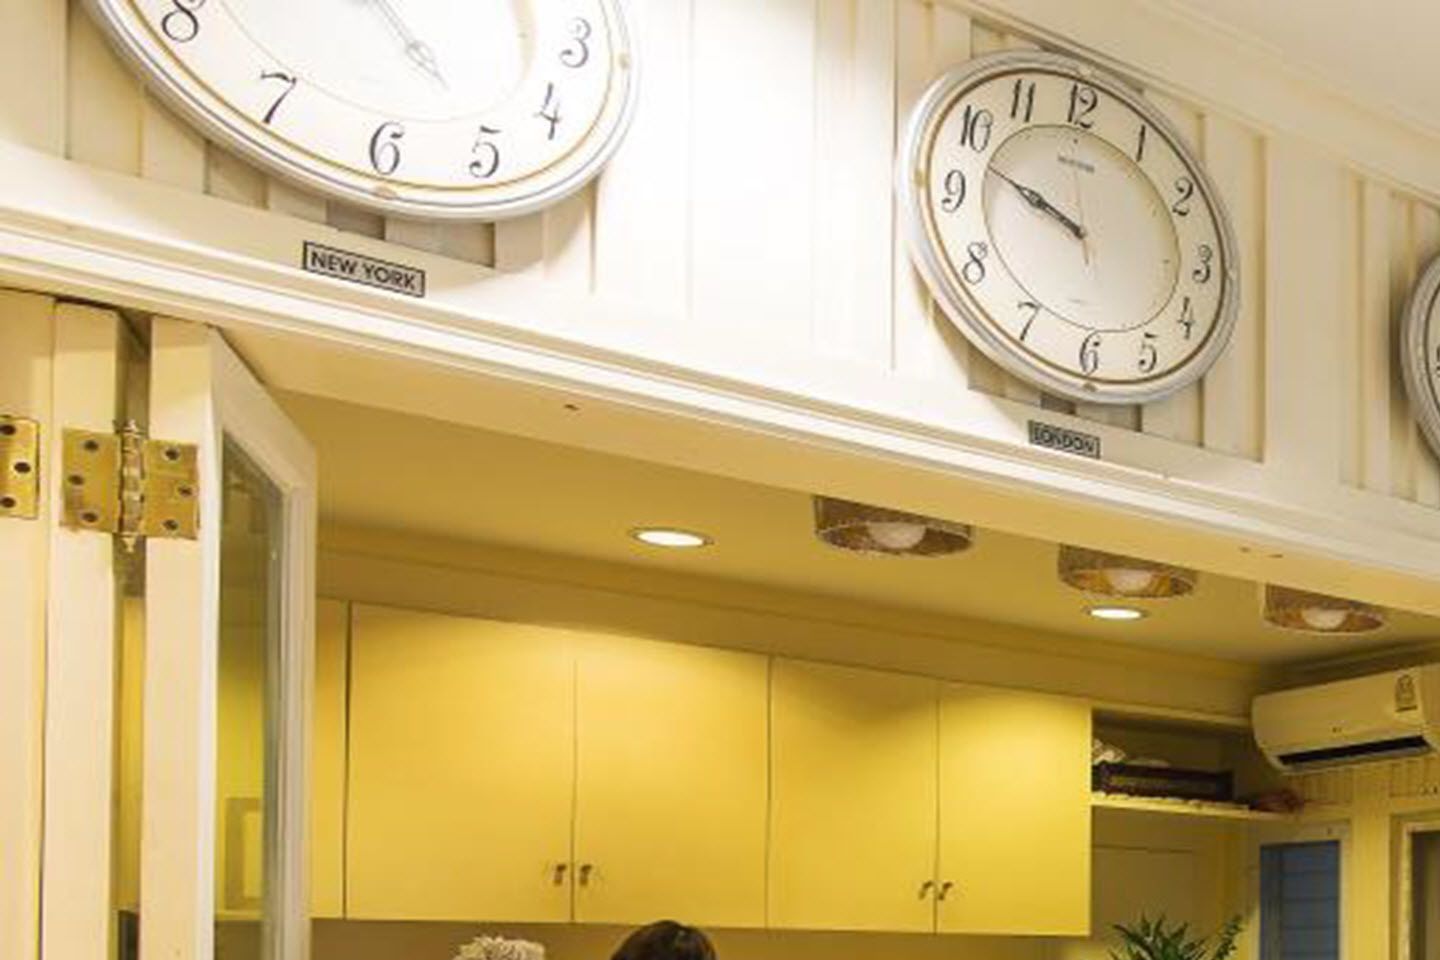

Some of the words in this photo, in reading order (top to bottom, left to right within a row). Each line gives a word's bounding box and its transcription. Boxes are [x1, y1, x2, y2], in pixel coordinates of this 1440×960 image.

[161, 0, 206, 43] 8
[560, 18, 592, 68] 3
[259, 72, 297, 124] 7
[533, 82, 560, 140] 4
[1010, 78, 1036, 123] 11
[1067, 83, 1098, 129] 12
[369, 121, 405, 175] 6
[960, 104, 994, 153] 10
[1136, 124, 1146, 162] 1
[468, 126, 499, 178] 5
[941, 169, 967, 213] 9
[1171, 176, 1193, 217] 2
[311, 250, 358, 275] NEW
[361, 263, 416, 290] YORK
[962, 240, 988, 285] 8
[1191, 244, 1212, 284] 3
[1017, 301, 1042, 341] 7
[1176, 296, 1195, 339] 4
[1079, 331, 1102, 374] 6
[1138, 332, 1157, 372] 5
[1034, 427, 1095, 452] LONDON
